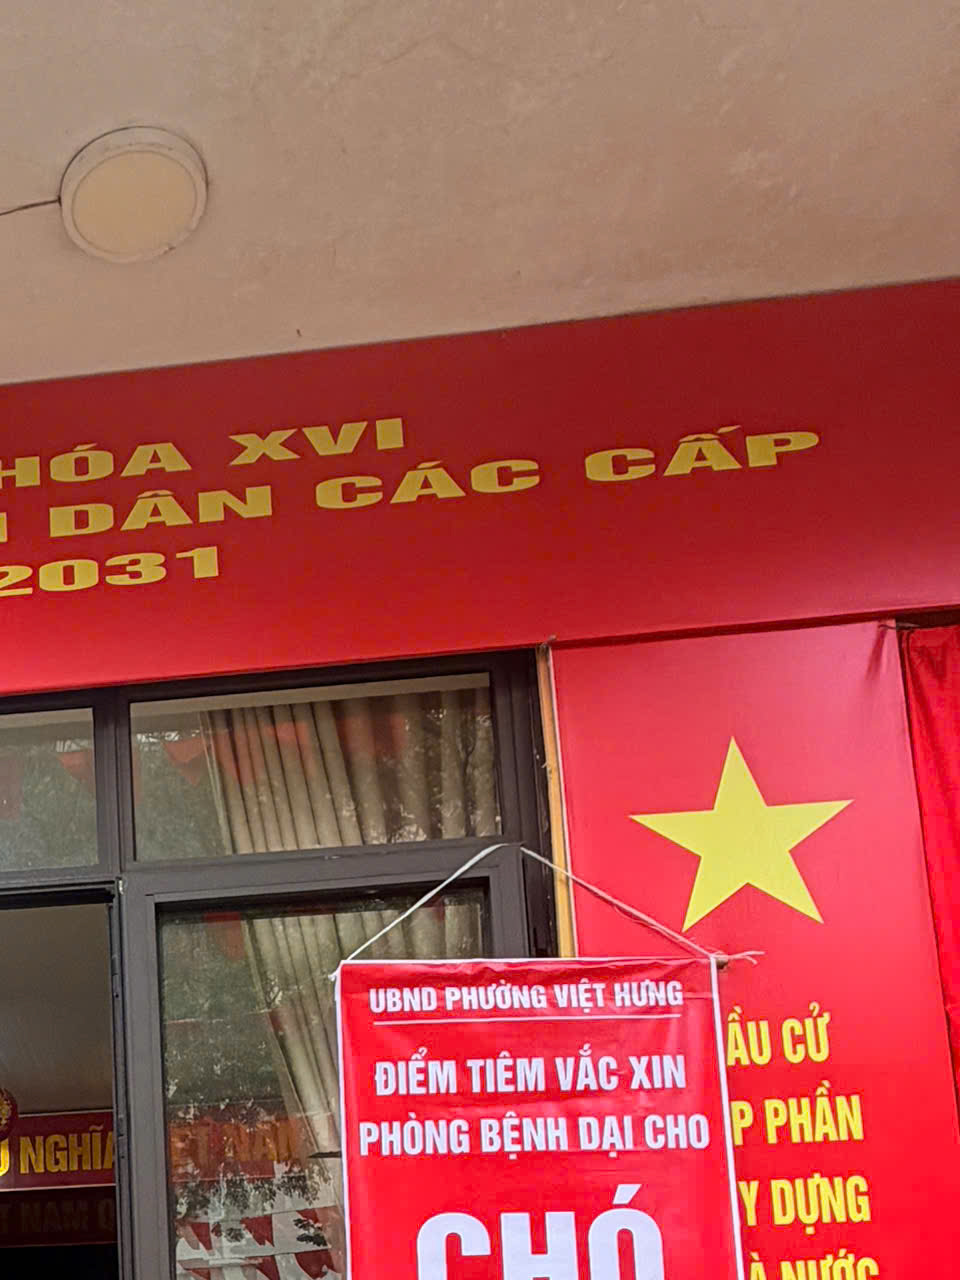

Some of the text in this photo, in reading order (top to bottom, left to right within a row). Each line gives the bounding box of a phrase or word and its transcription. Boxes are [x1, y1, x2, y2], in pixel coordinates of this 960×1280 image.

[228, 418, 404, 465] XVI
[49, 485, 272, 537] DÂN
[315, 458, 540, 509] CÁC
[584, 425, 820, 482] CẤP
[369, 979, 684, 1013] UBND PHƯỜNG VIỆT HƯNG
[781, 1001, 831, 1064] CỬ
[374, 1043, 687, 1097] ĐIỂM TIÊM VẮC XIN
[359, 1111, 709, 1160] PHÒNG BỆNH DẠI CHO
[764, 1080, 864, 1144] PHẦN
[770, 1173, 871, 1235] DỰNG
